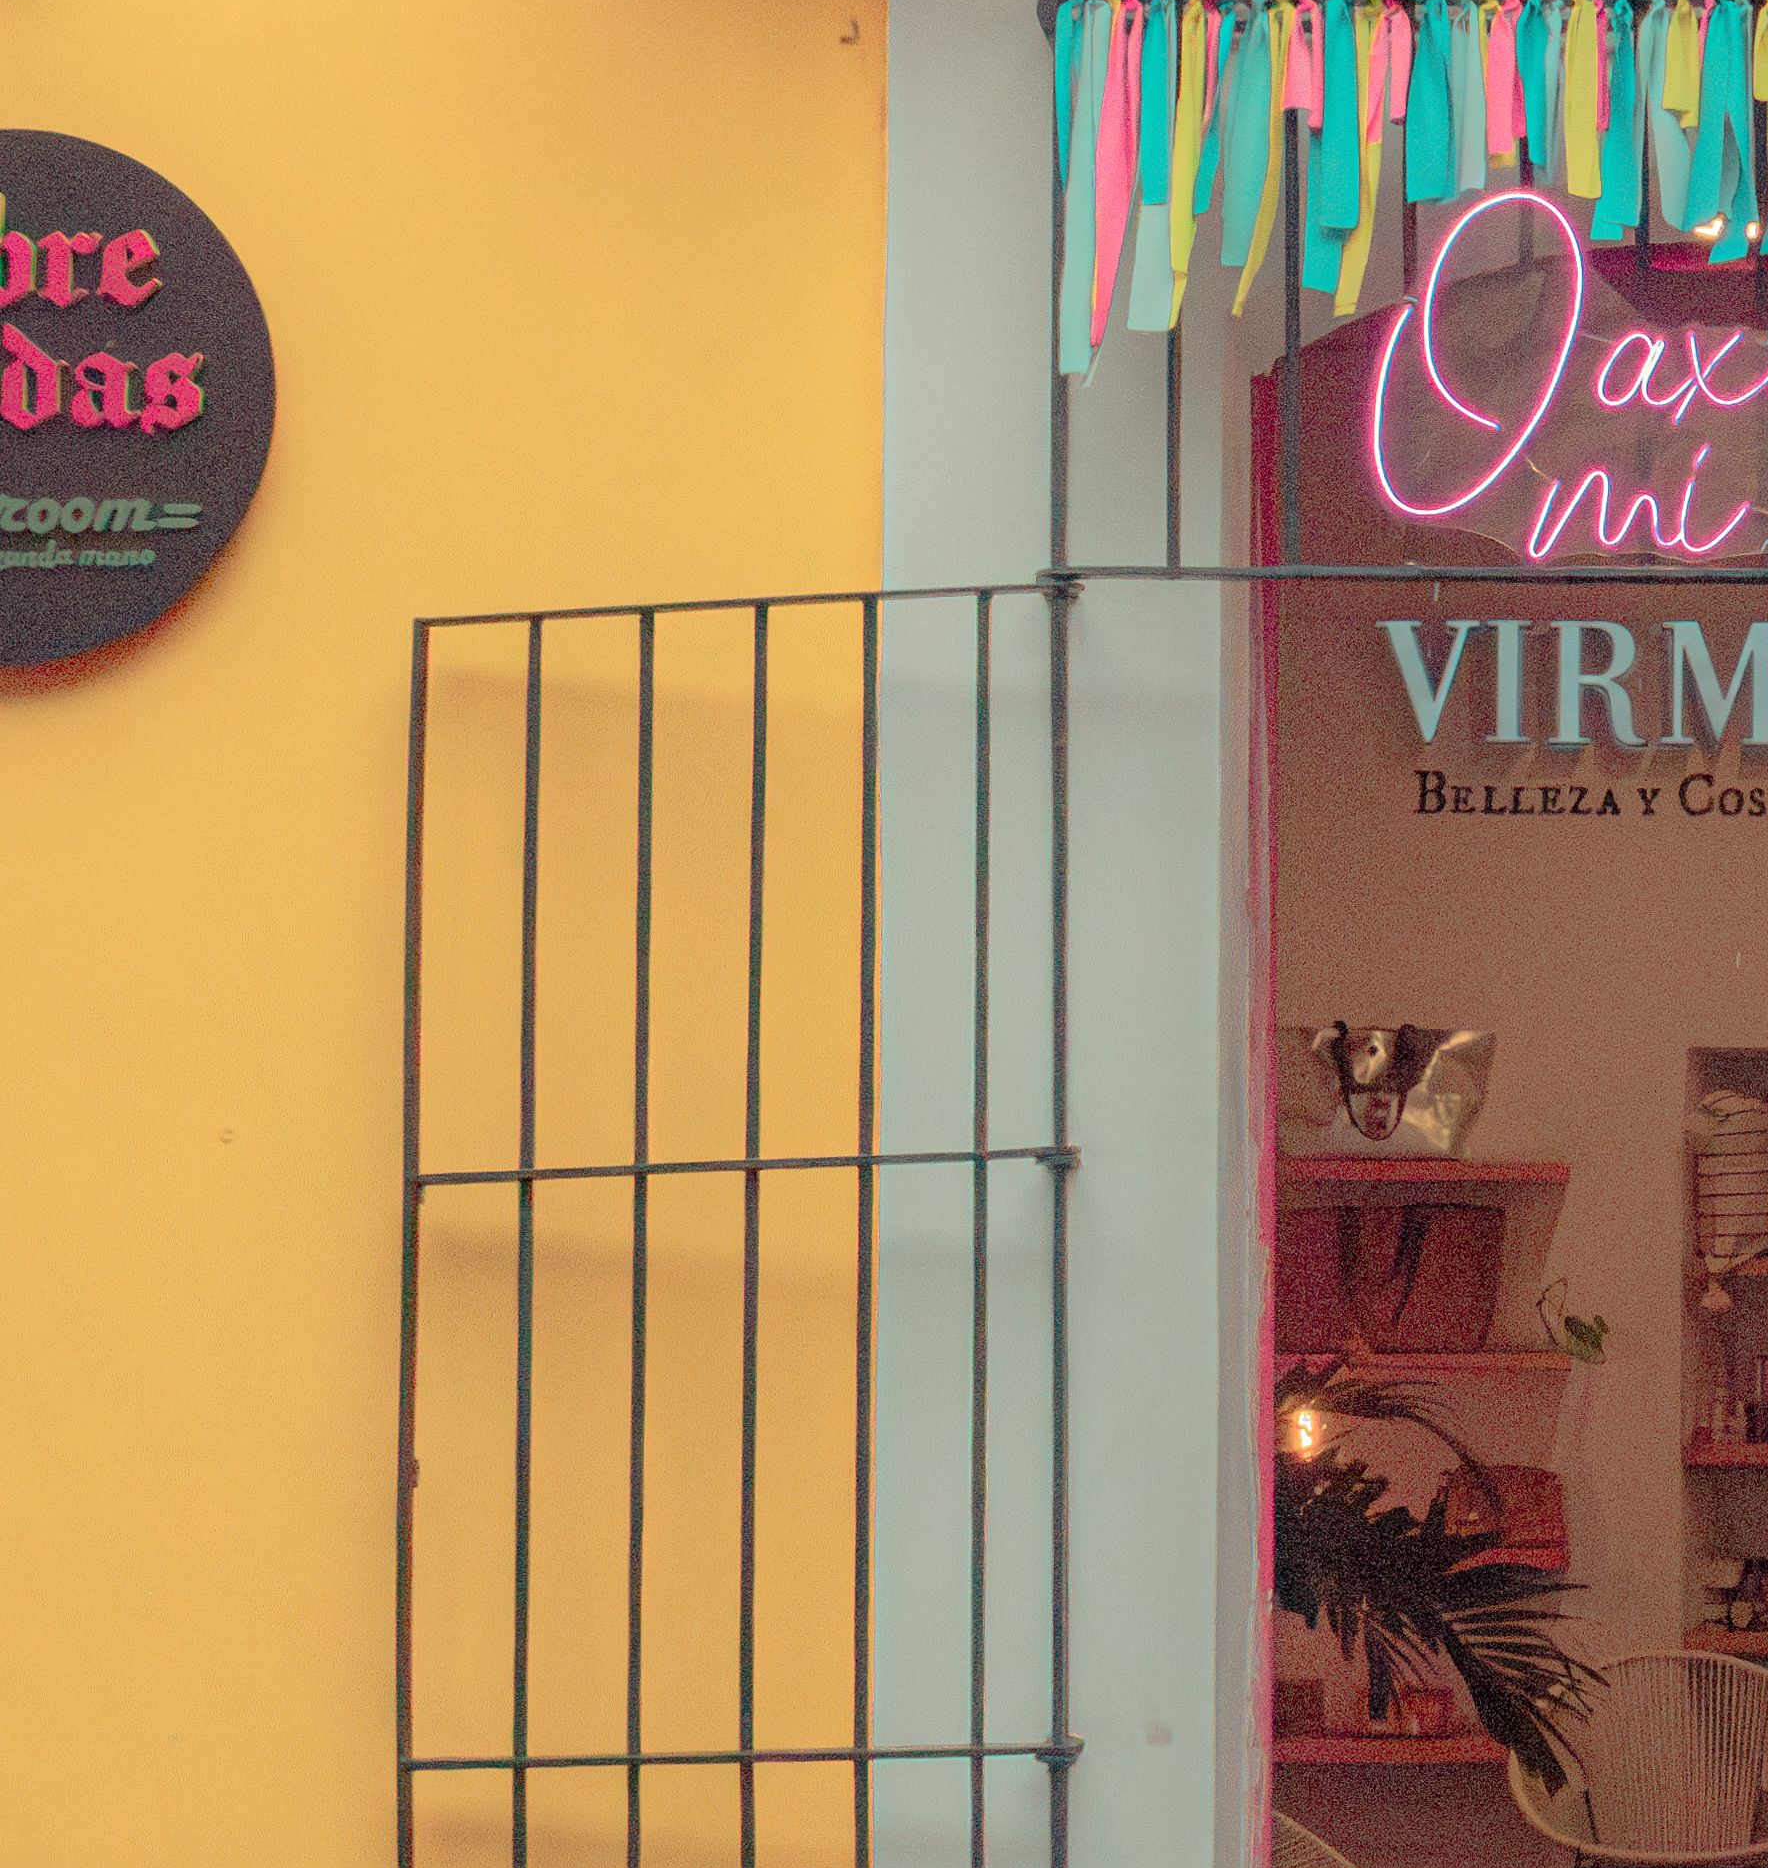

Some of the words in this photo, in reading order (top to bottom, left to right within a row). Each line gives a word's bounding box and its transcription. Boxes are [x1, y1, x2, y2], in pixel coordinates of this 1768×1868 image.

[0, 323, 205, 434] das
[77, 548, 156, 567] mano
[1528, 443, 1752, 561] mi
